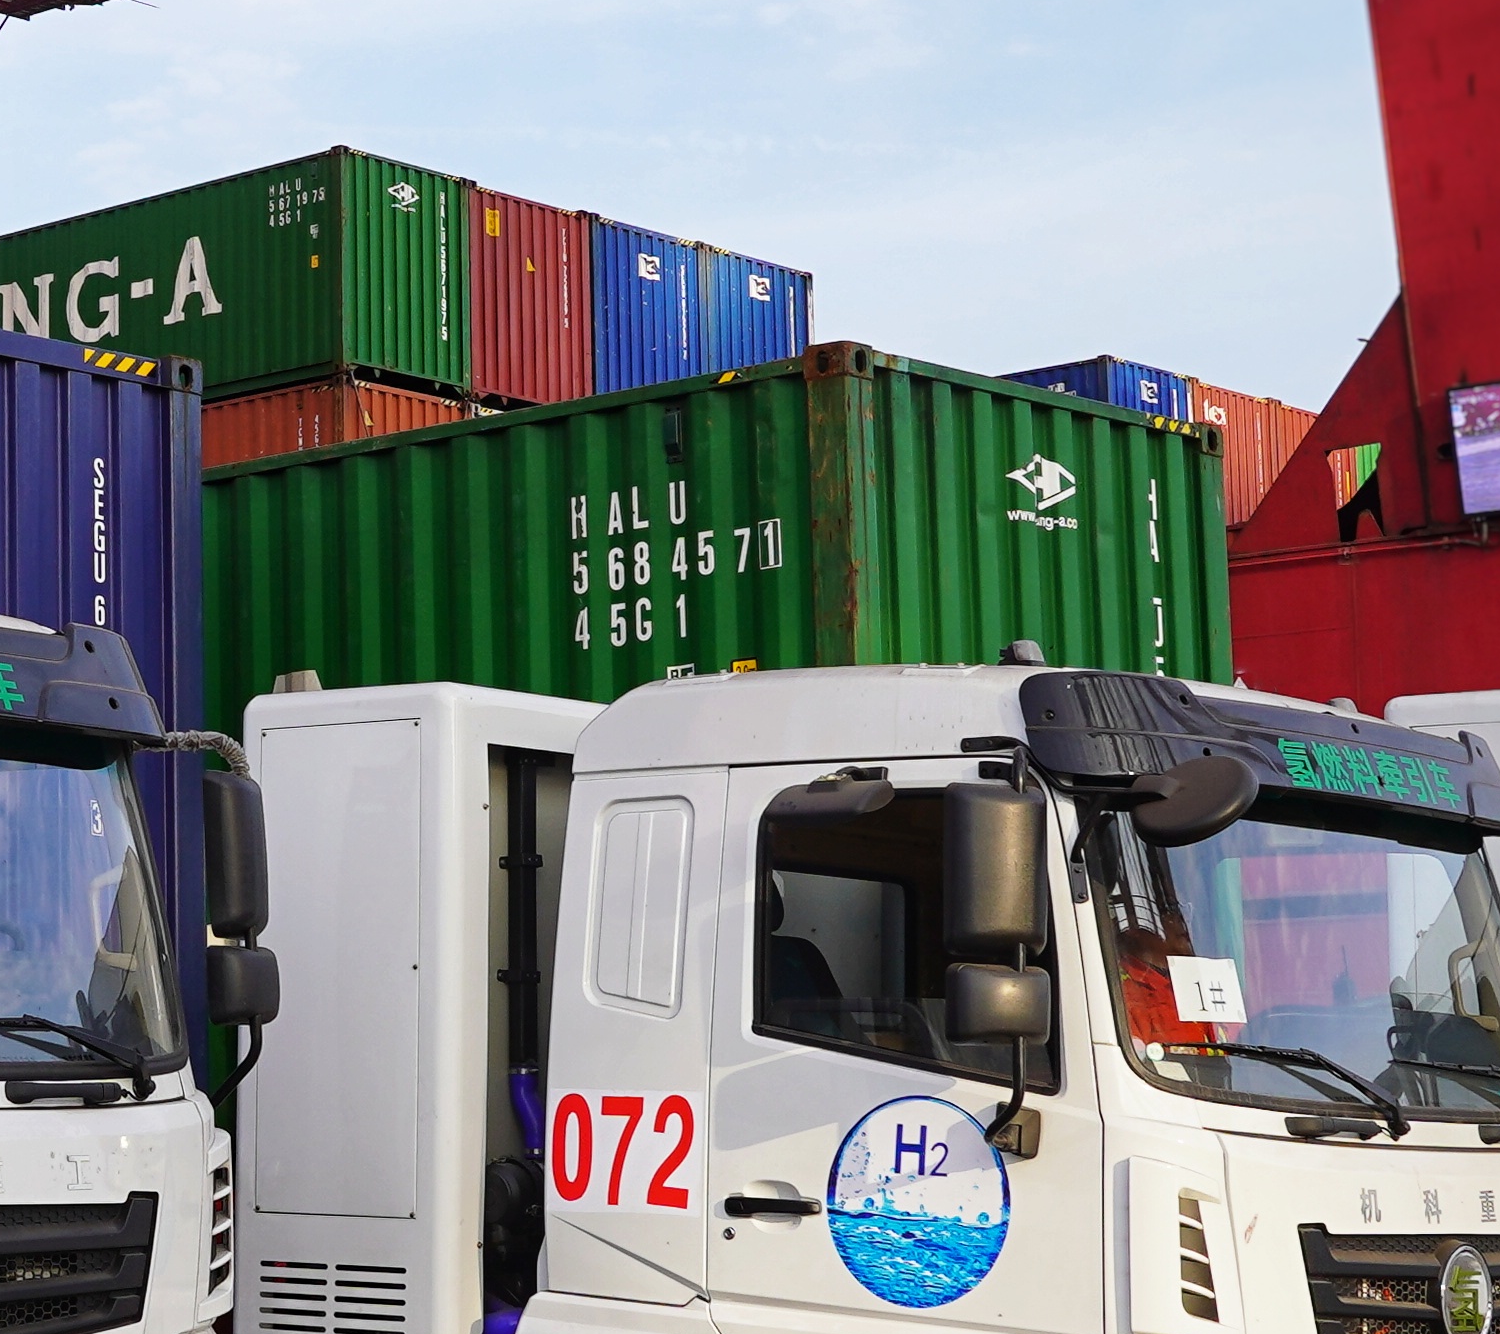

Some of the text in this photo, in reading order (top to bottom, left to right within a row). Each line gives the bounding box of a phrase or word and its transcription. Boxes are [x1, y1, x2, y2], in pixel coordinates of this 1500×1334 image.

[269, 178, 301, 197] HALU
[269, 209, 301, 227] 45G1
[571, 480, 687, 540] HALU
[93, 457, 106, 626] SEGU 6
[575, 594, 687, 650] 45G1
[1277, 737, 1462, 809] 氢燃料牵引车
[1194, 981, 1226, 1012] 1#
[552, 1093, 695, 1209] 072
[894, 1123, 949, 1177] H2
